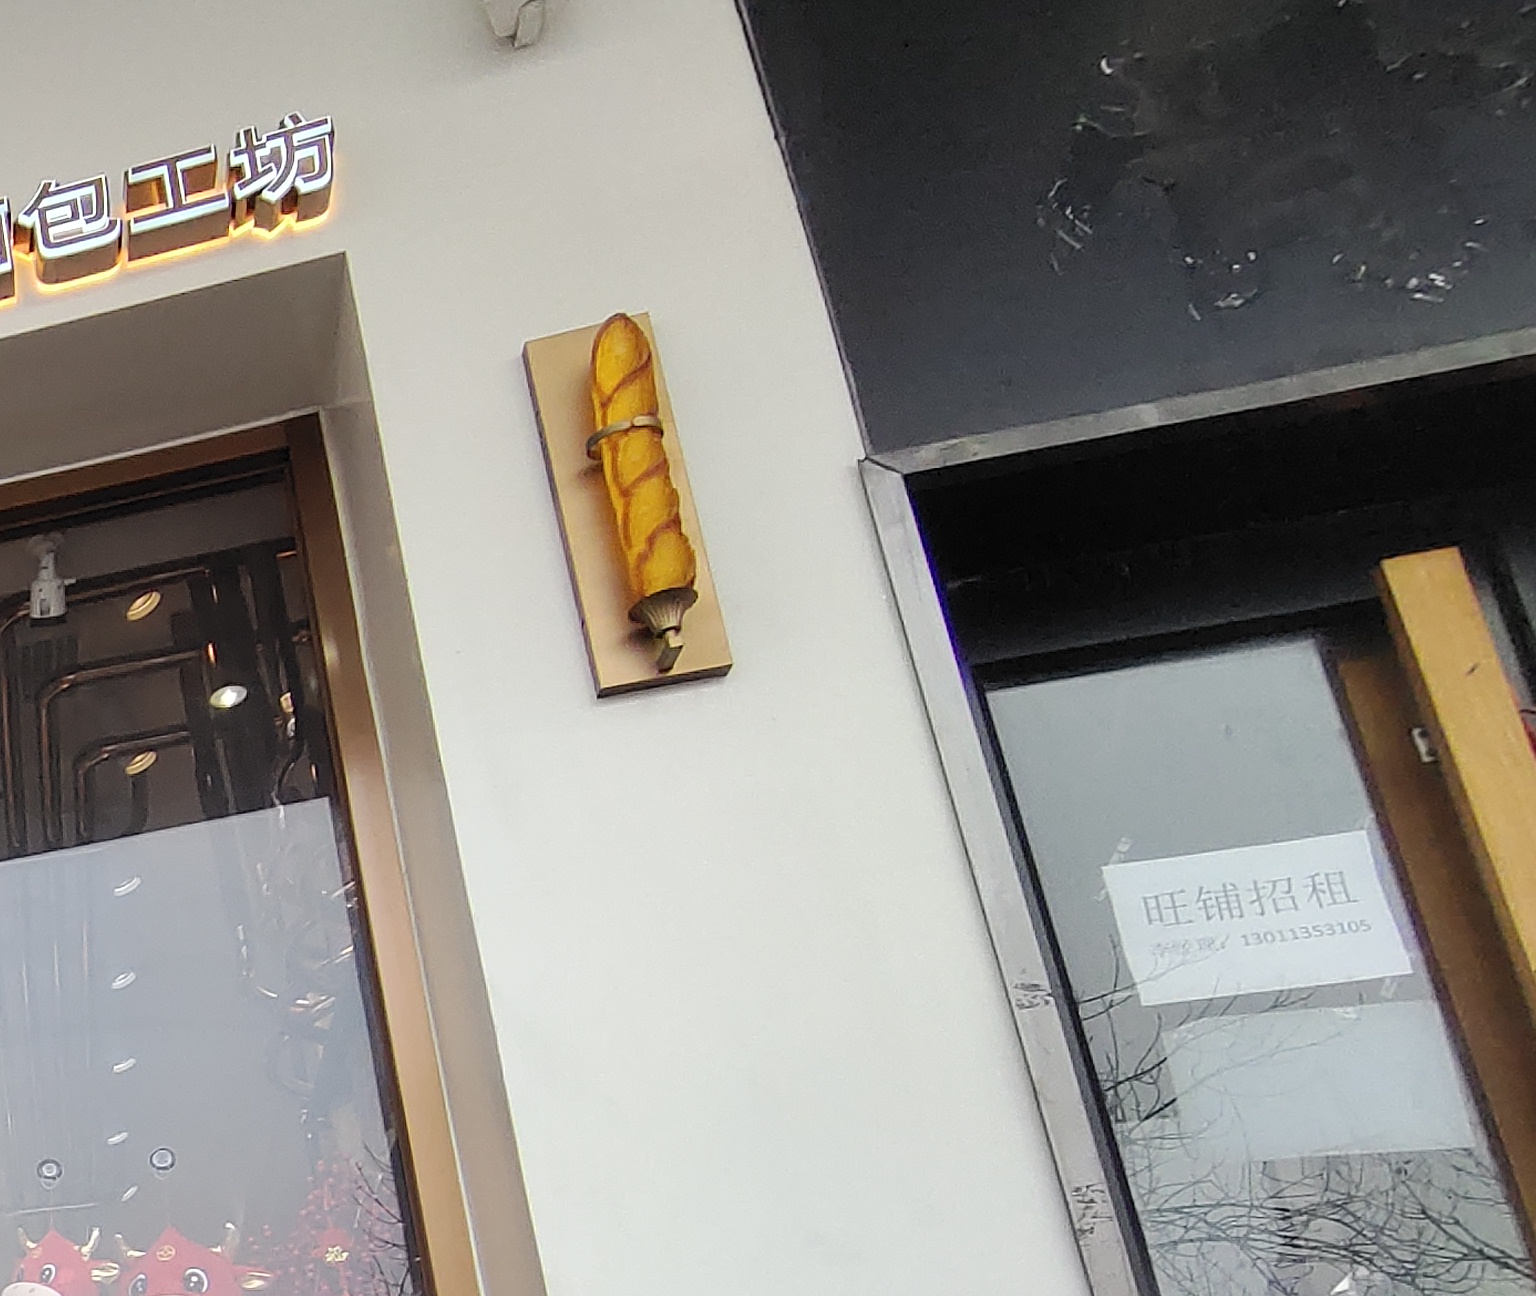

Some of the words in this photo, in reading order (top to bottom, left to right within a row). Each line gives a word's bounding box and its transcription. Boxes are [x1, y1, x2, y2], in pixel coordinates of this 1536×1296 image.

[1142, 871, 1359, 928] 旺铺招租
[1240, 919, 1372, 947] 13011353105
